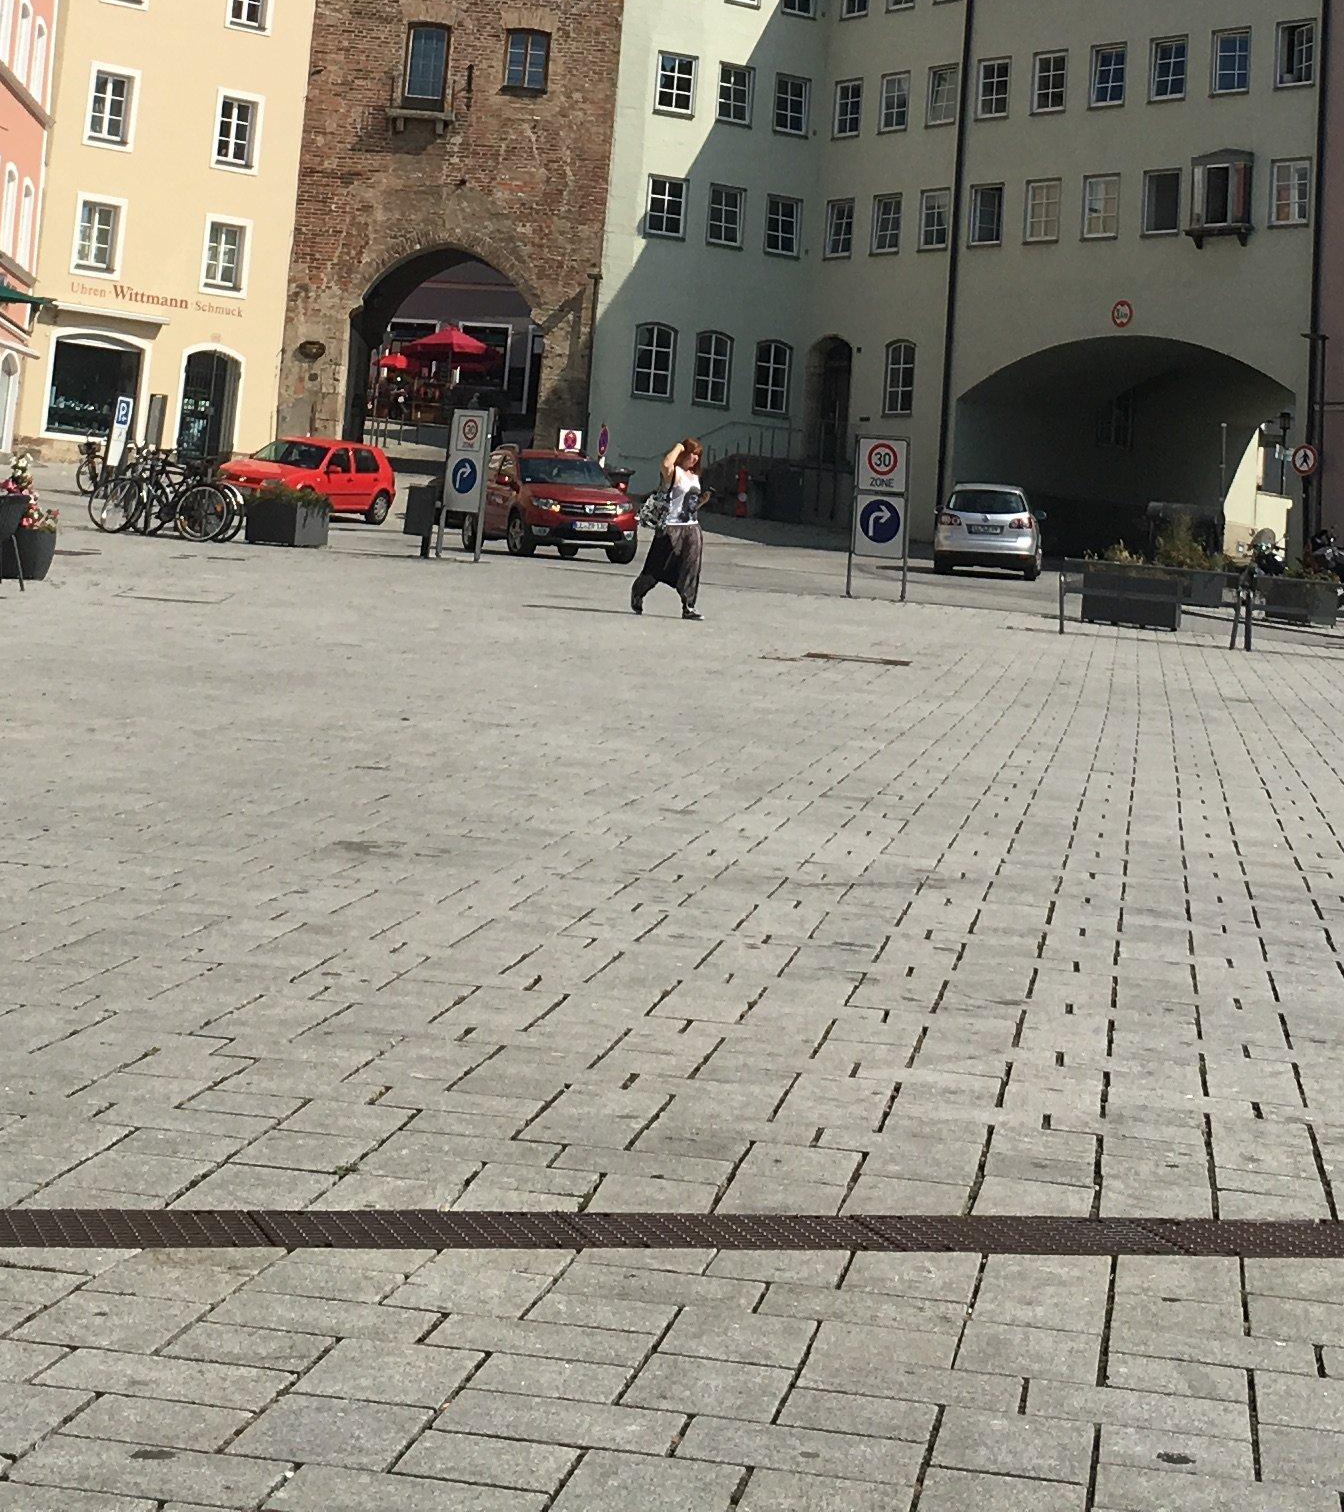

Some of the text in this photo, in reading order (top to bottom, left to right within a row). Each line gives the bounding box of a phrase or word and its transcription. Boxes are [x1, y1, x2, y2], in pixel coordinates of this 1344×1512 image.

[71, 281, 244, 318] Uhren Wittmann Schmuck
[874, 451, 892, 467] 30
[869, 477, 895, 488] ZONE
